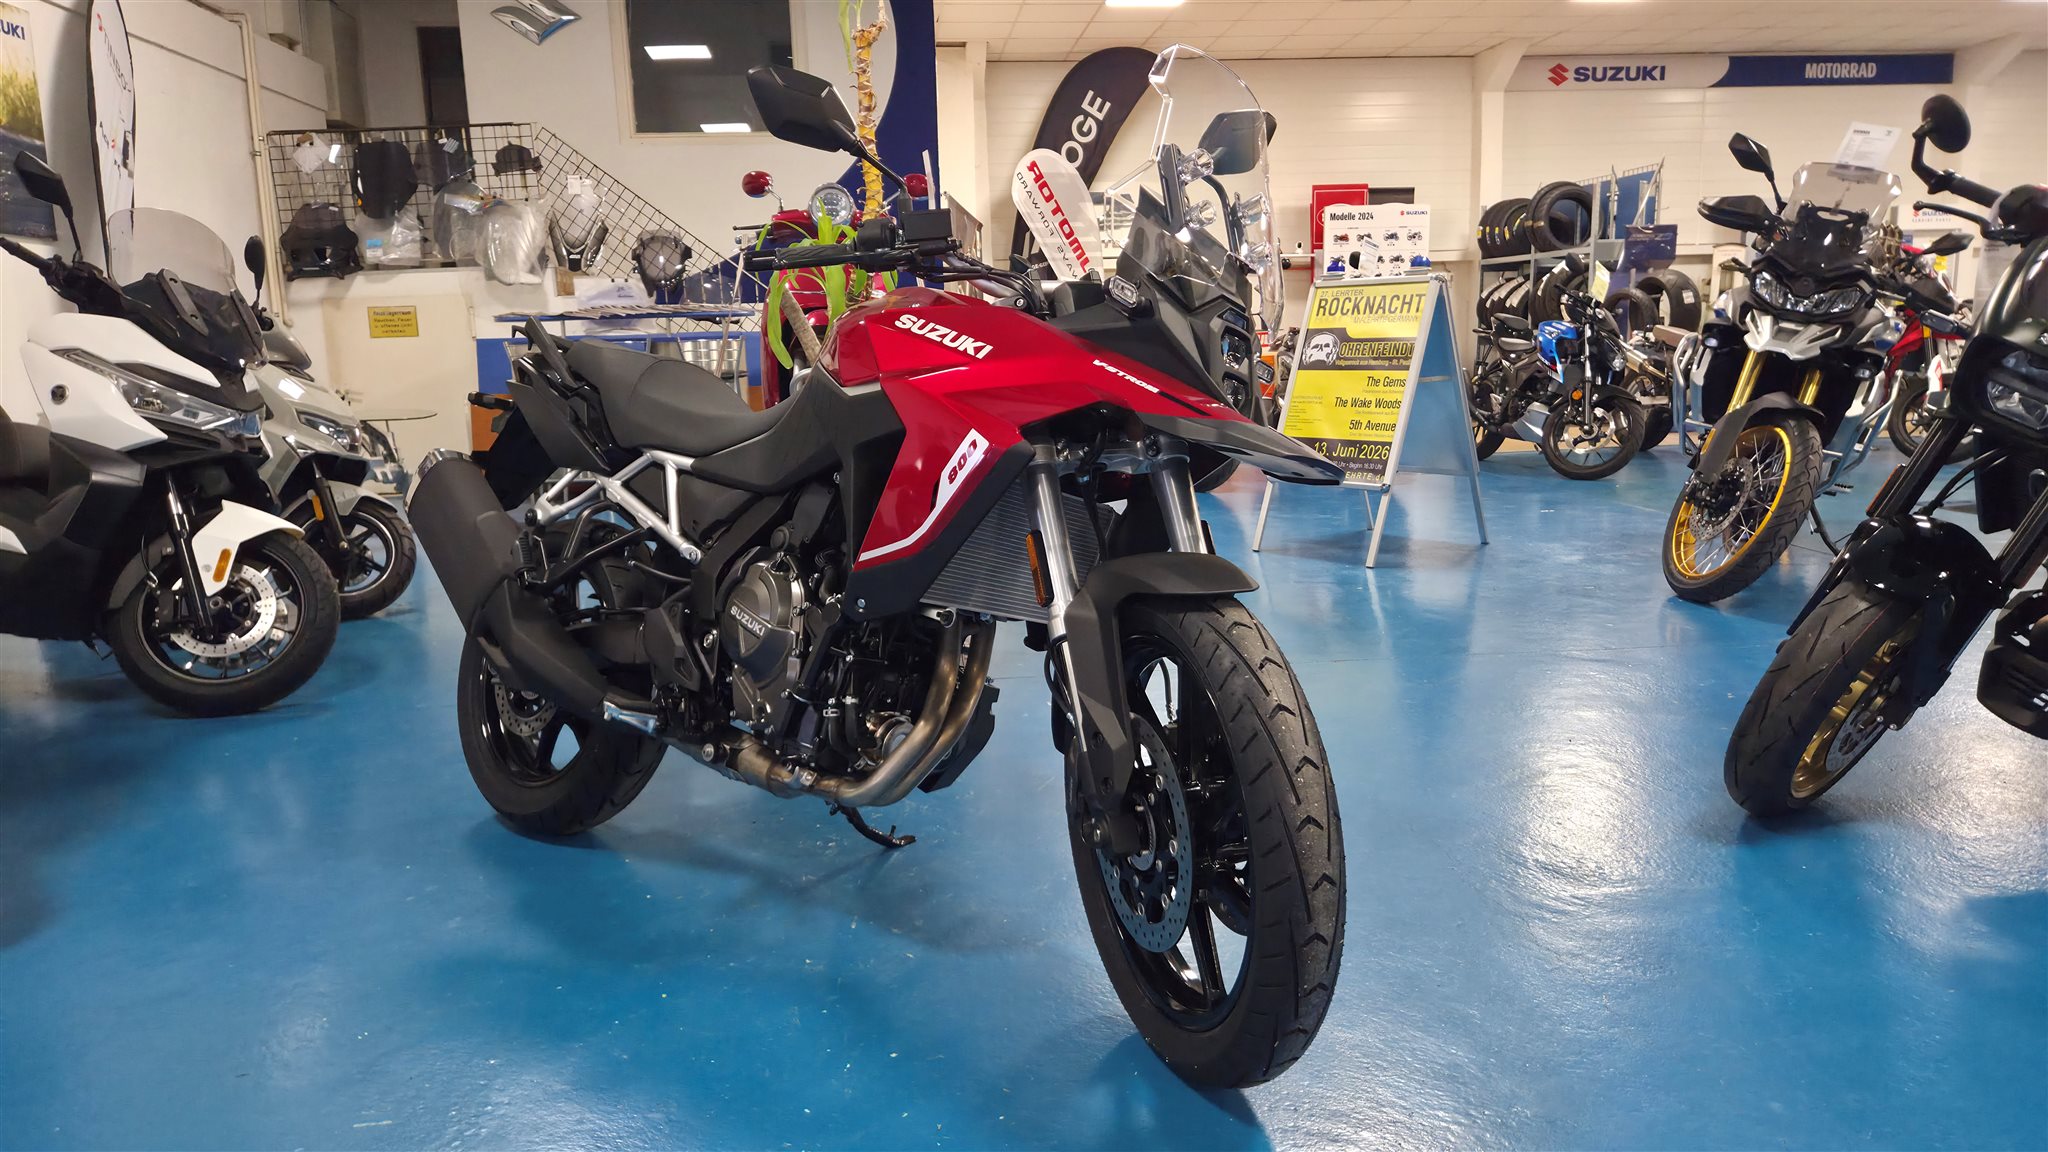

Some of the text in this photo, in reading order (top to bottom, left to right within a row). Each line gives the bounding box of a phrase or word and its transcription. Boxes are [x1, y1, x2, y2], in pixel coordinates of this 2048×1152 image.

[0, 19, 25, 40] UKI
[1573, 65, 1665, 82] SUZUKI
[1805, 62, 1877, 78] MOTORRAD
[1329, 212, 1374, 221] Modelle 2024
[1331, 289, 1364, 297] LEHRTER
[1315, 293, 1426, 317] ROCKNACHT
[894, 314, 994, 360] SUZUKI
[1339, 341, 1415, 358] OHRENFEINDT
[1093, 359, 1160, 394] V-STROM
[1366, 376, 1406, 388] The Gems
[1334, 397, 1348, 408] The
[1350, 397, 1372, 409] Wake
[1374, 397, 1402, 409] Woods
[1349, 419, 1396, 432] 5th Avenue
[1314, 442, 1390, 460] 13. Juni 2026
[730, 605, 765, 637] SUZUKI
